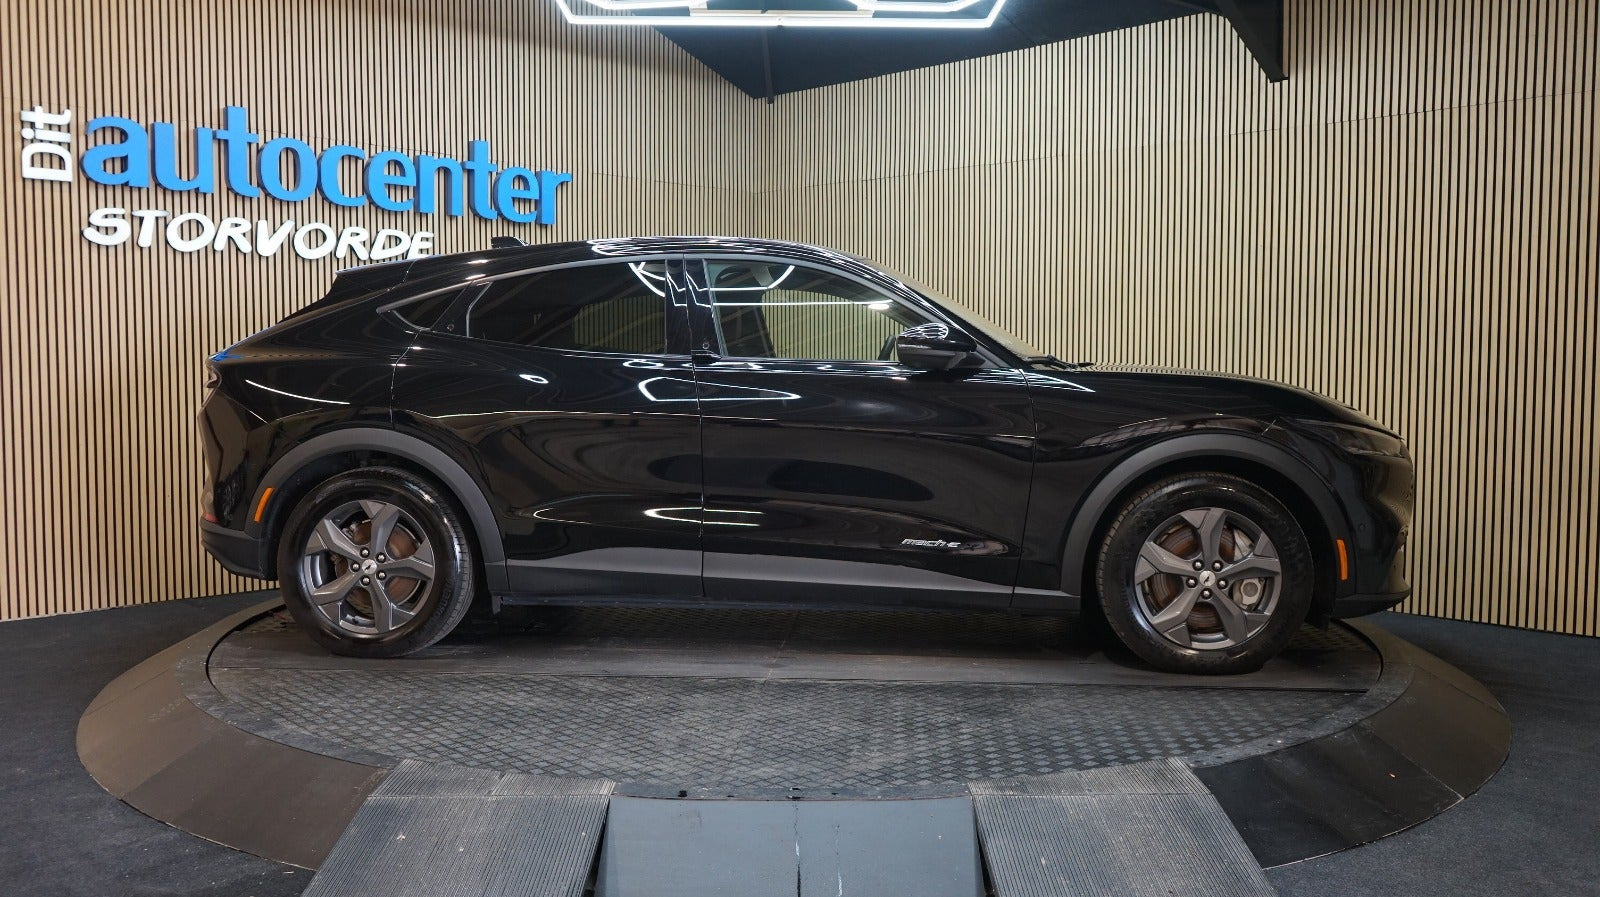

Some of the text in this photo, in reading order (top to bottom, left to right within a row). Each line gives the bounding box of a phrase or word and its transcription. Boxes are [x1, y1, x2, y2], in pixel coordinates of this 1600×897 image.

[20, 105, 573, 225] Dit autocenter
[83, 207, 434, 260] STORVORDE
